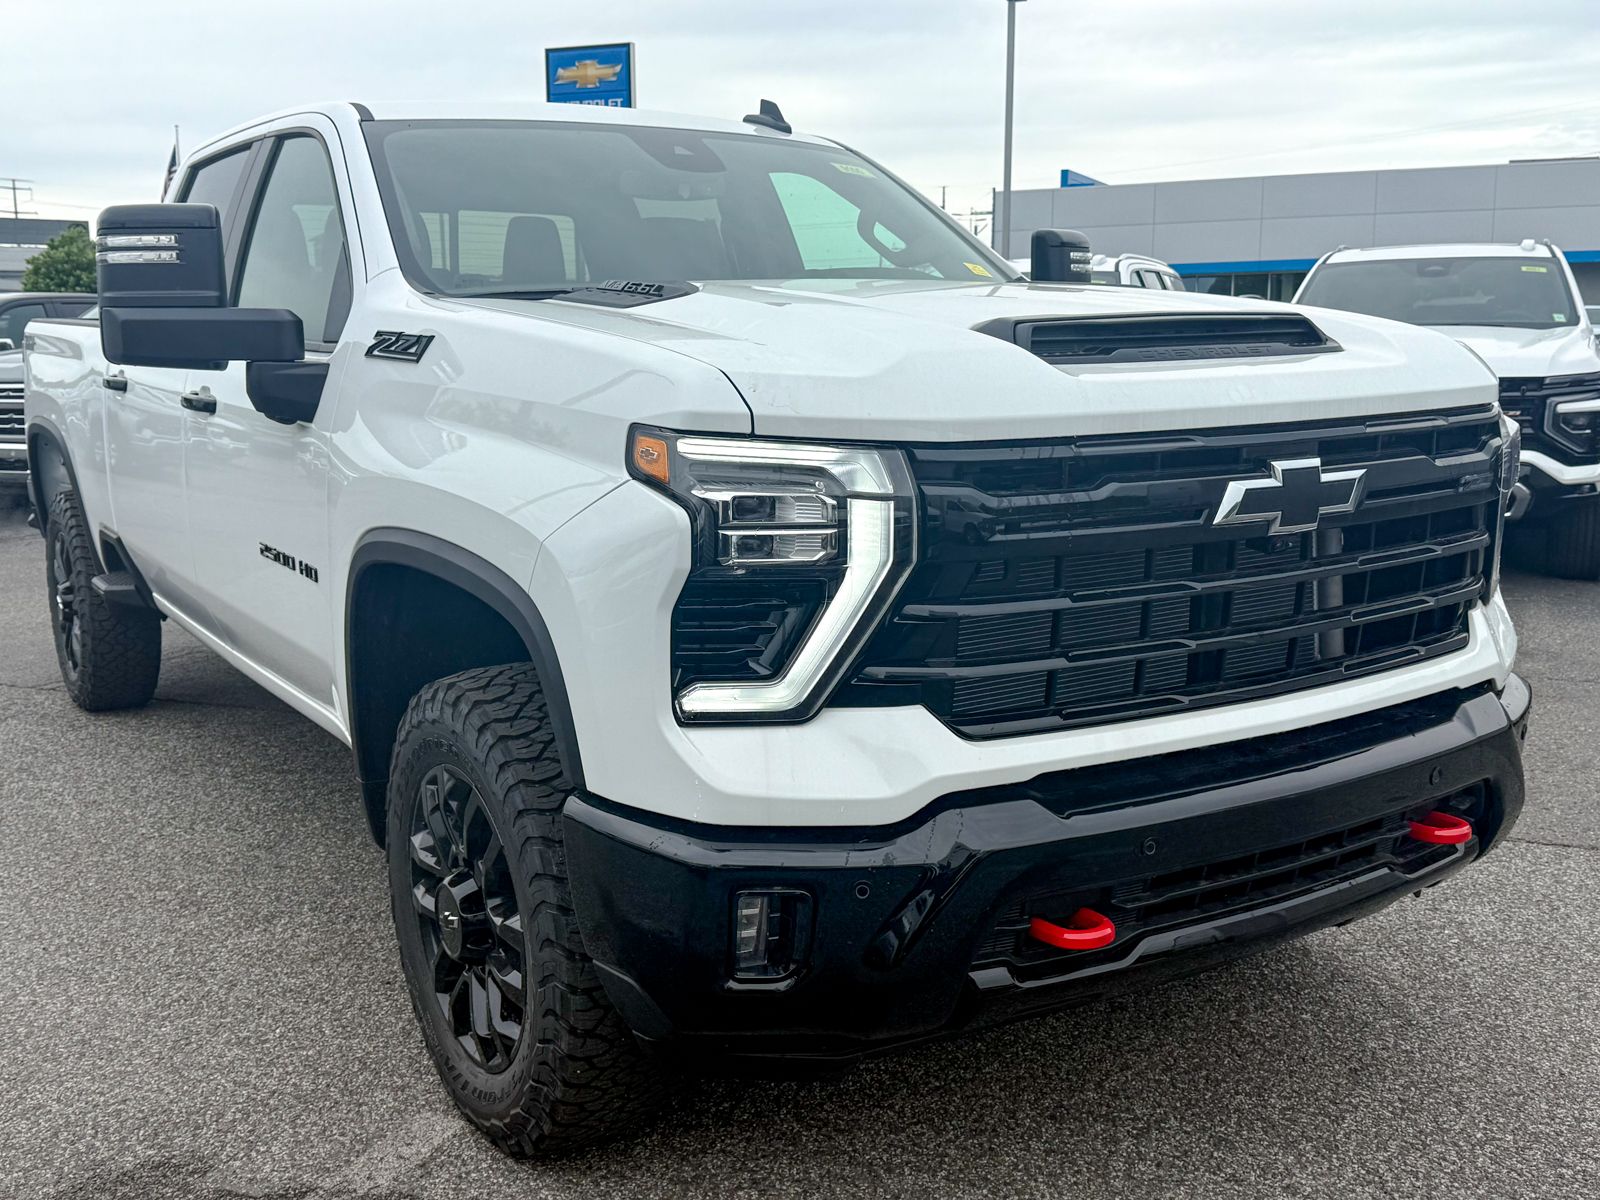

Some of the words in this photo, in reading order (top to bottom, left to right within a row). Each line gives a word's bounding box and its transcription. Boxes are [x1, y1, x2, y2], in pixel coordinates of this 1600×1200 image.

[364, 330, 435, 364] Z71
[1138, 345, 1272, 360] CHEVROLET
[259, 541, 296, 571] 2500
[299, 560, 318, 583] HD
